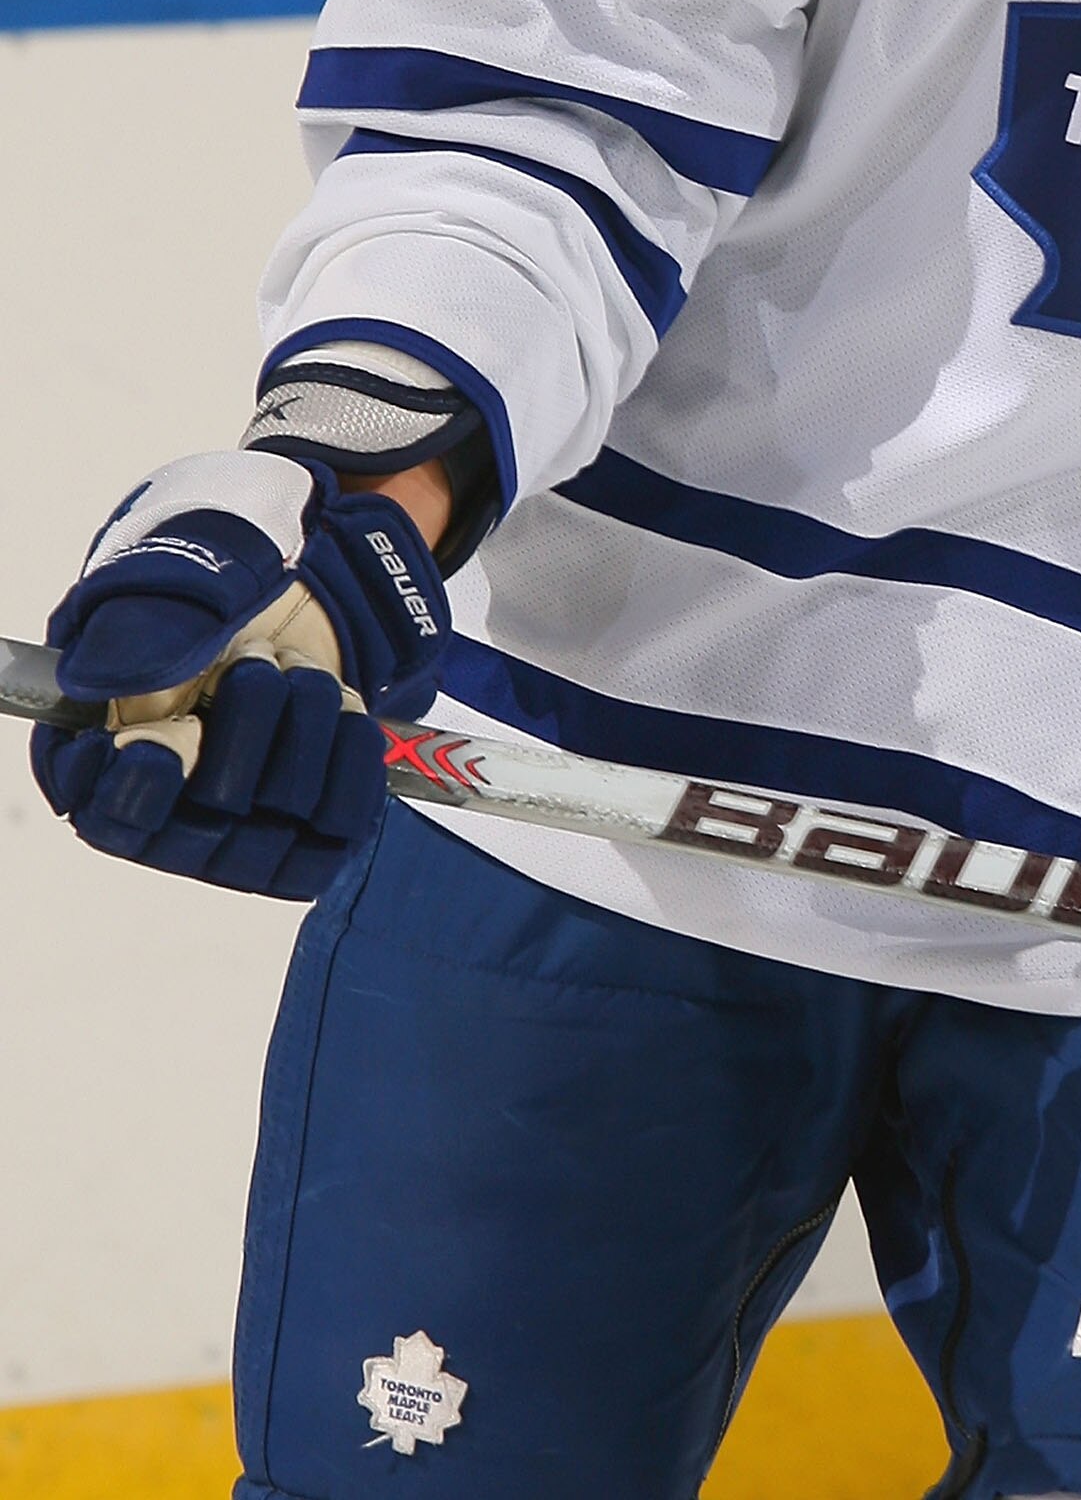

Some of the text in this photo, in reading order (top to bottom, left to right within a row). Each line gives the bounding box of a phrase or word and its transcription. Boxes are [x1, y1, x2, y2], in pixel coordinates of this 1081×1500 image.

[364, 531, 438, 637] BAUER
[381, 1378, 442, 1403] TORONTO
[388, 1394, 430, 1414] MAPLE
[389, 1407, 425, 1425] LEAFS
